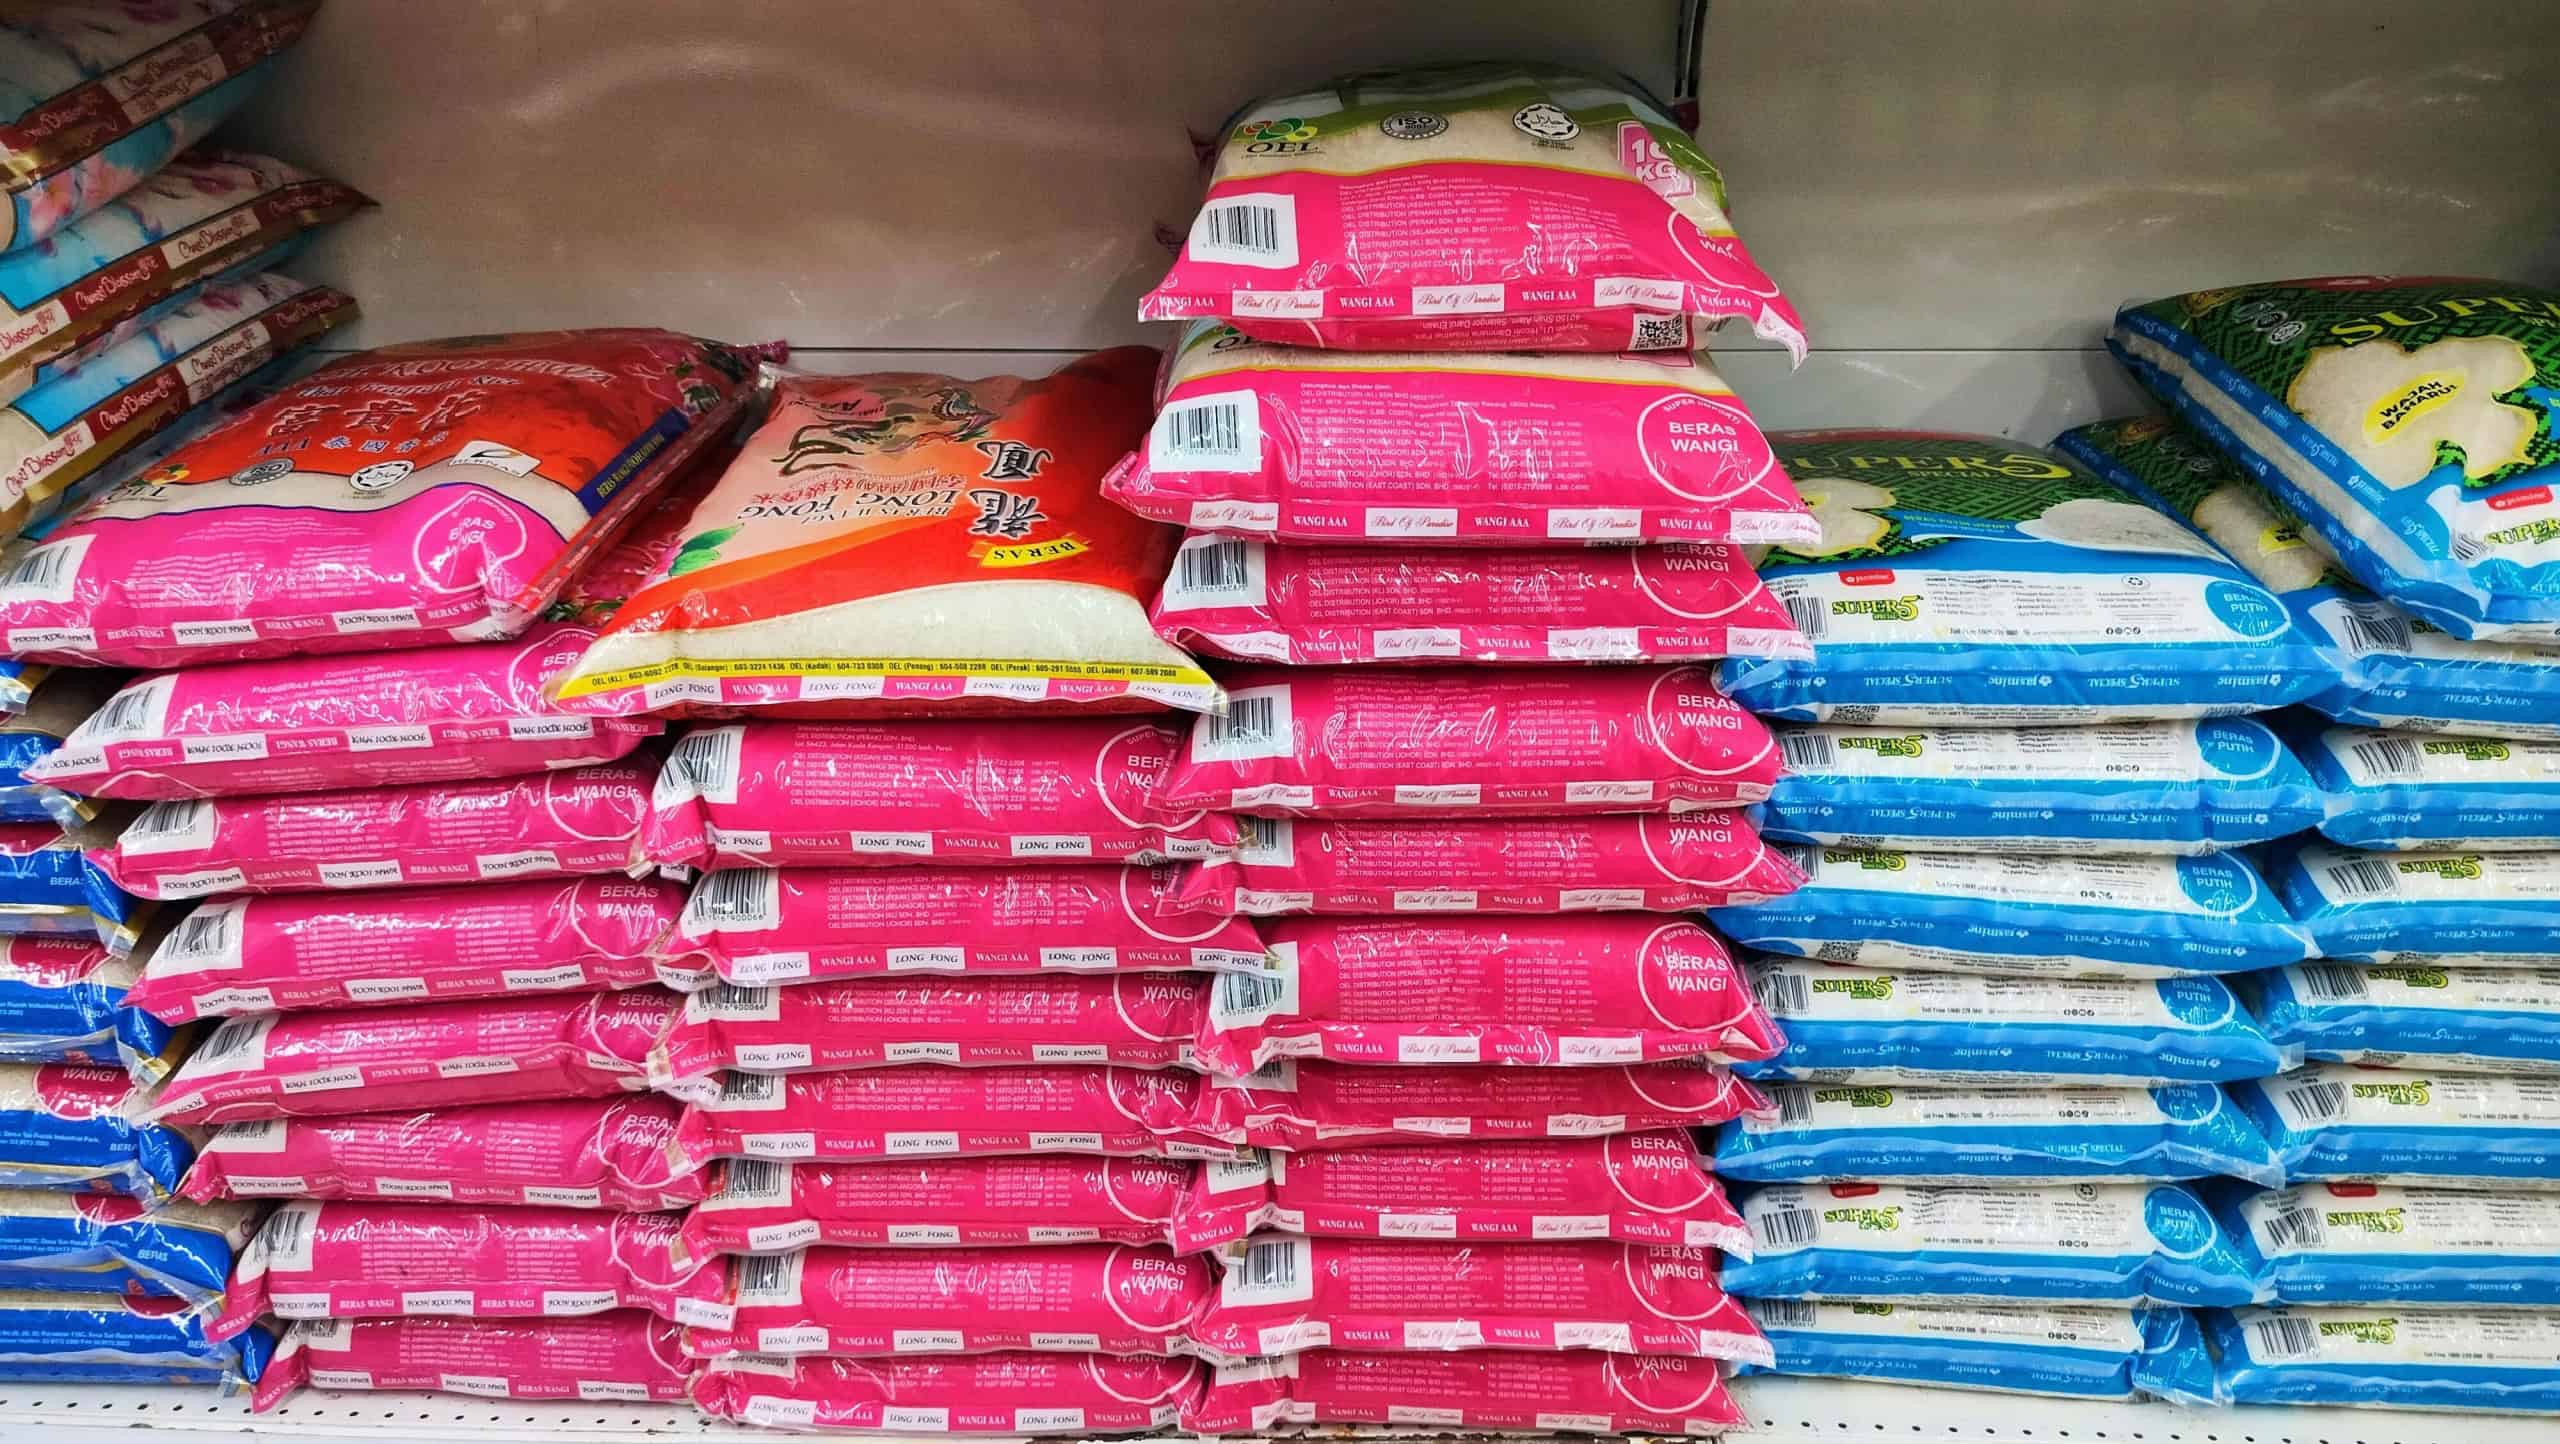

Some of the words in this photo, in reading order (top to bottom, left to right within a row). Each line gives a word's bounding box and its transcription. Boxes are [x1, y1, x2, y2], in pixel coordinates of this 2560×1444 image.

[1397, 117, 1433, 128] ISO
[1246, 142, 1320, 154] OEL
[1358, 211, 1406, 220] DISTRIBUTION
[1359, 230, 1408, 239] DISTRIBUTION
[1522, 290, 1553, 301] WANGI
[1555, 290, 1577, 300] AAA
[1700, 294, 1730, 307] WANGI
[1731, 297, 1752, 308] AAA
[1193, 296, 1215, 308] AAA
[1339, 297, 1371, 308] WANGI
[1373, 297, 1395, 308] AAA
[2380, 380, 2443, 418] WAJAH
[2381, 383, 2458, 431] BAHARU!
[1669, 421, 1737, 436] BERAS
[1671, 438, 1740, 454] WANGI
[1314, 481, 1364, 489] DISTRIBUTION
[858, 489, 956, 507] LONG
[736, 493, 837, 520] FONG
[1293, 515, 1325, 527] WANGI
[1326, 515, 1348, 527] AAA
[1475, 517, 1508, 528] WANGI
[1509, 517, 1530, 528] AAA
[1659, 518, 1692, 530] WANGI
[1693, 519, 1713, 531] AAA
[992, 541, 1076, 560] BERAS
[1662, 545, 1729, 558] BERAS
[1663, 558, 1730, 573] WANGI
[1325, 609, 1370, 617] DISTRIBUTION
[2231, 603, 2269, 614] PUTIH
[1655, 636, 1689, 648] WANGI
[1690, 636, 1710, 647] AAA
[592, 676, 605, 687] OEL
[790, 662, 804, 671] OEL
[889, 663, 903, 672] OEL
[904, 663, 934, 673] (Penang)
[991, 664, 1004, 673] OEL
[1005, 664, 1031, 674] (Perak)
[1086, 666, 1099, 675] OEL
[655, 685, 682, 699] LONG
[688, 684, 715, 694] FONG
[809, 682, 839, 691] LONG
[846, 682, 878, 690] FONG
[895, 682, 930, 692] WANGI
[932, 682, 953, 692] AAA
[1677, 694, 1741, 712] BERAS
[1678, 712, 1743, 730] WANGI
[2216, 742, 2255, 753] PUTIH
[576, 768, 637, 780] BERAS
[573, 785, 634, 799] WANGI
[1668, 813, 1731, 826] BERAS
[1670, 828, 1733, 843] WANGI
[860, 838, 890, 848] LONG
[896, 839, 926, 849] FONG
[1019, 841, 1049, 851] LONG
[1055, 840, 1086, 850] FONG
[2196, 877, 2233, 889] PUTIH
[600, 886, 659, 899] BERAS
[597, 904, 656, 919] WANGI
[1048, 953, 1076, 962] LONG
[1081, 952, 1111, 962] FONG
[1200, 953, 1227, 963] LONG
[1231, 956, 1259, 968] FONG
[1668, 974, 1728, 992] WANGI
[2177, 990, 2211, 1001] PUTIH
[1041, 1049, 1068, 1057] LONG
[1073, 1048, 1102, 1057] FONG
[63, 1069, 118, 1082] WANGI
[1135, 1075, 1188, 1093] WANGI
[894, 1138, 920, 1148] LONG
[925, 1137, 953, 1147] FONG
[2090, 1144, 2124, 1154] SPECIAL
[1631, 1154, 1688, 1170] WANGI
[895, 1230, 923, 1239] LONG
[927, 1230, 954, 1239] FONG
[1132, 1259, 1187, 1275] BERAS
[1649, 1263, 1704, 1280] WANGI
[1132, 1275, 1184, 1292] WANGI
[340, 1300, 365, 1309] BERAS
[367, 1300, 394, 1309] WANGI
[1633, 1356, 1688, 1373] WANGI
[959, 1415, 986, 1424] WANGI
[987, 1415, 1006, 1424] AAA
[1022, 1416, 1047, 1425] LONG
[1052, 1414, 1079, 1424] FONG
